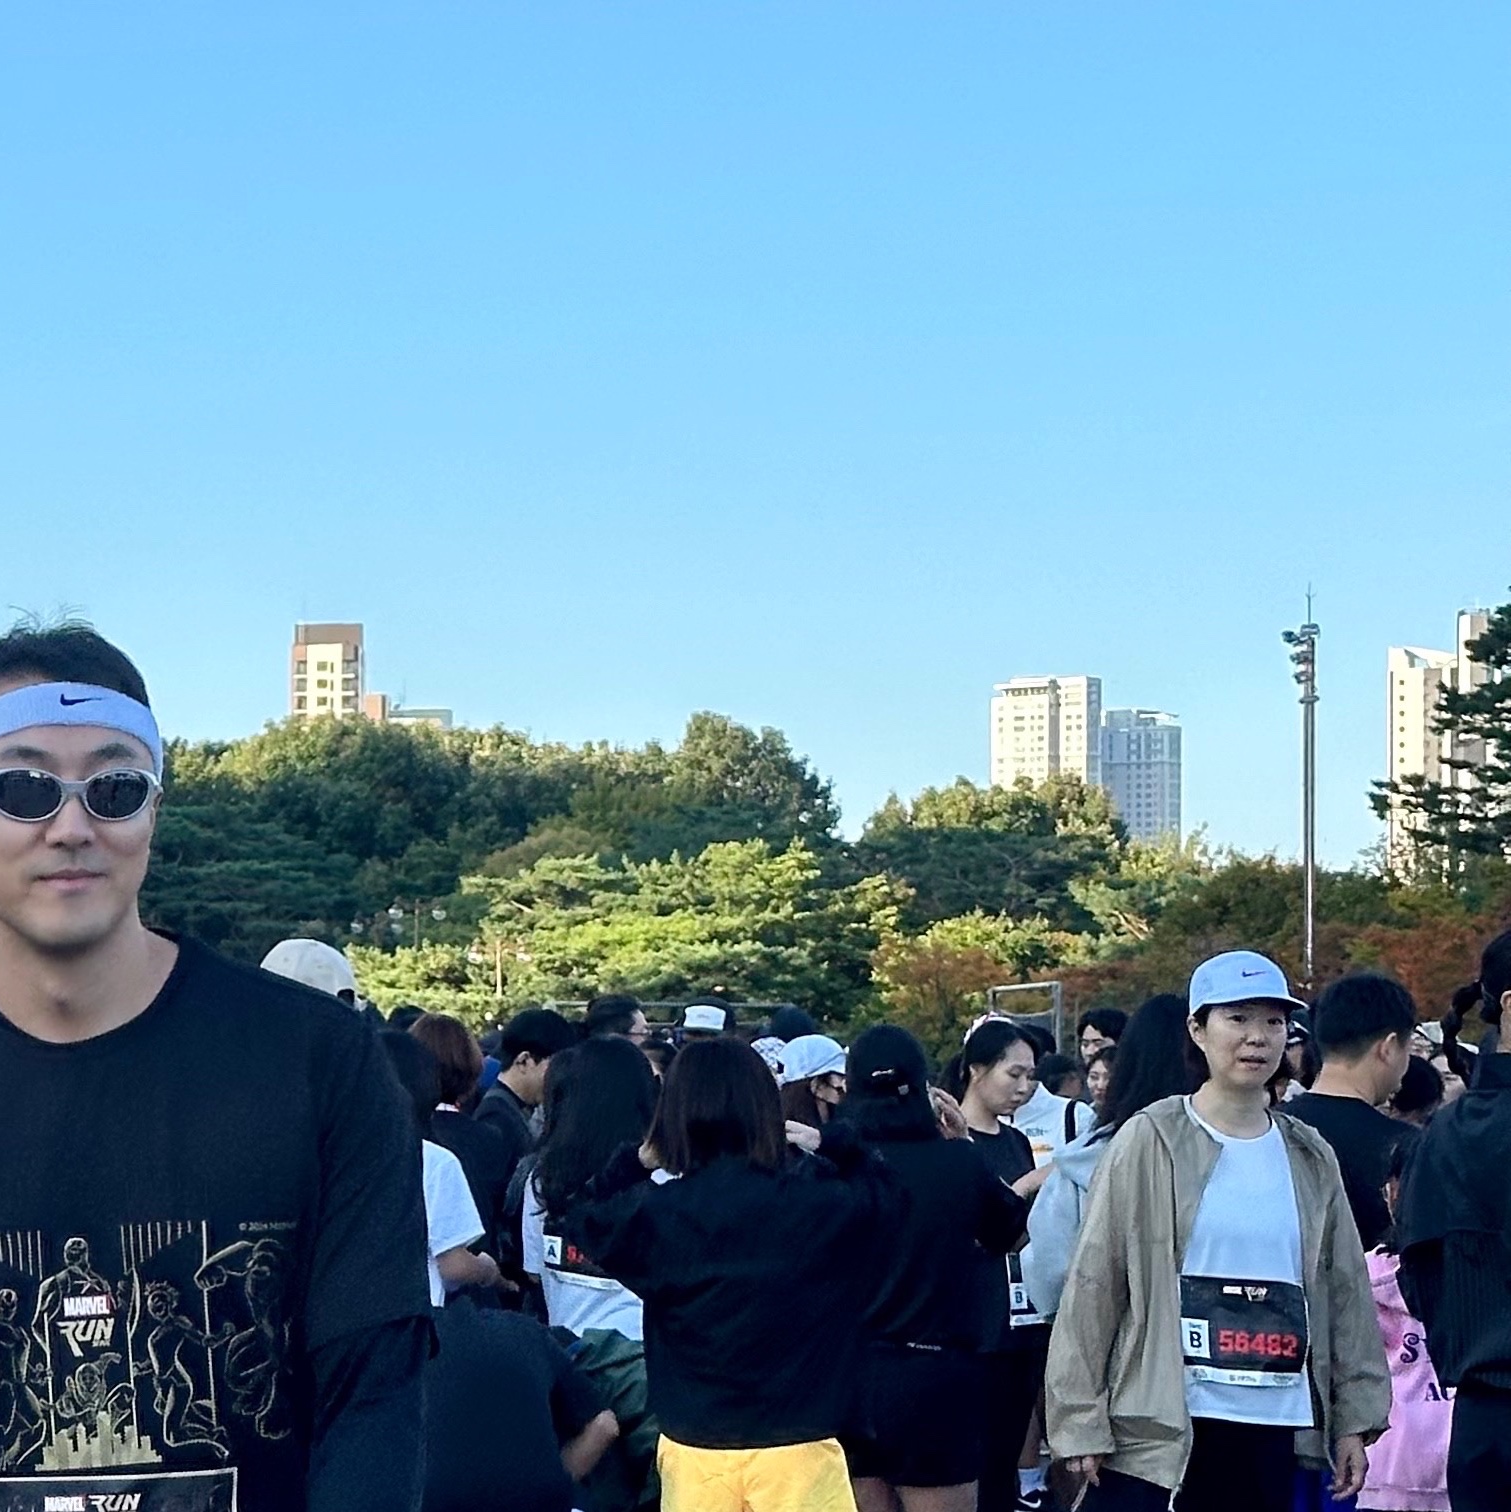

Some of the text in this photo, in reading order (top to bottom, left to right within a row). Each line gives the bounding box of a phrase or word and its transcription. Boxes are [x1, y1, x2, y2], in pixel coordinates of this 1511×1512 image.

[548, 1244, 557, 1258] A
[63, 1296, 110, 1317] MARVEL
[56, 1318, 115, 1357] RUN
[1189, 1331, 1203, 1348] B
[1218, 1329, 1299, 1358] 56482
[1400, 1332, 1426, 1364] S
[44, 1495, 86, 1512] MARVEL
